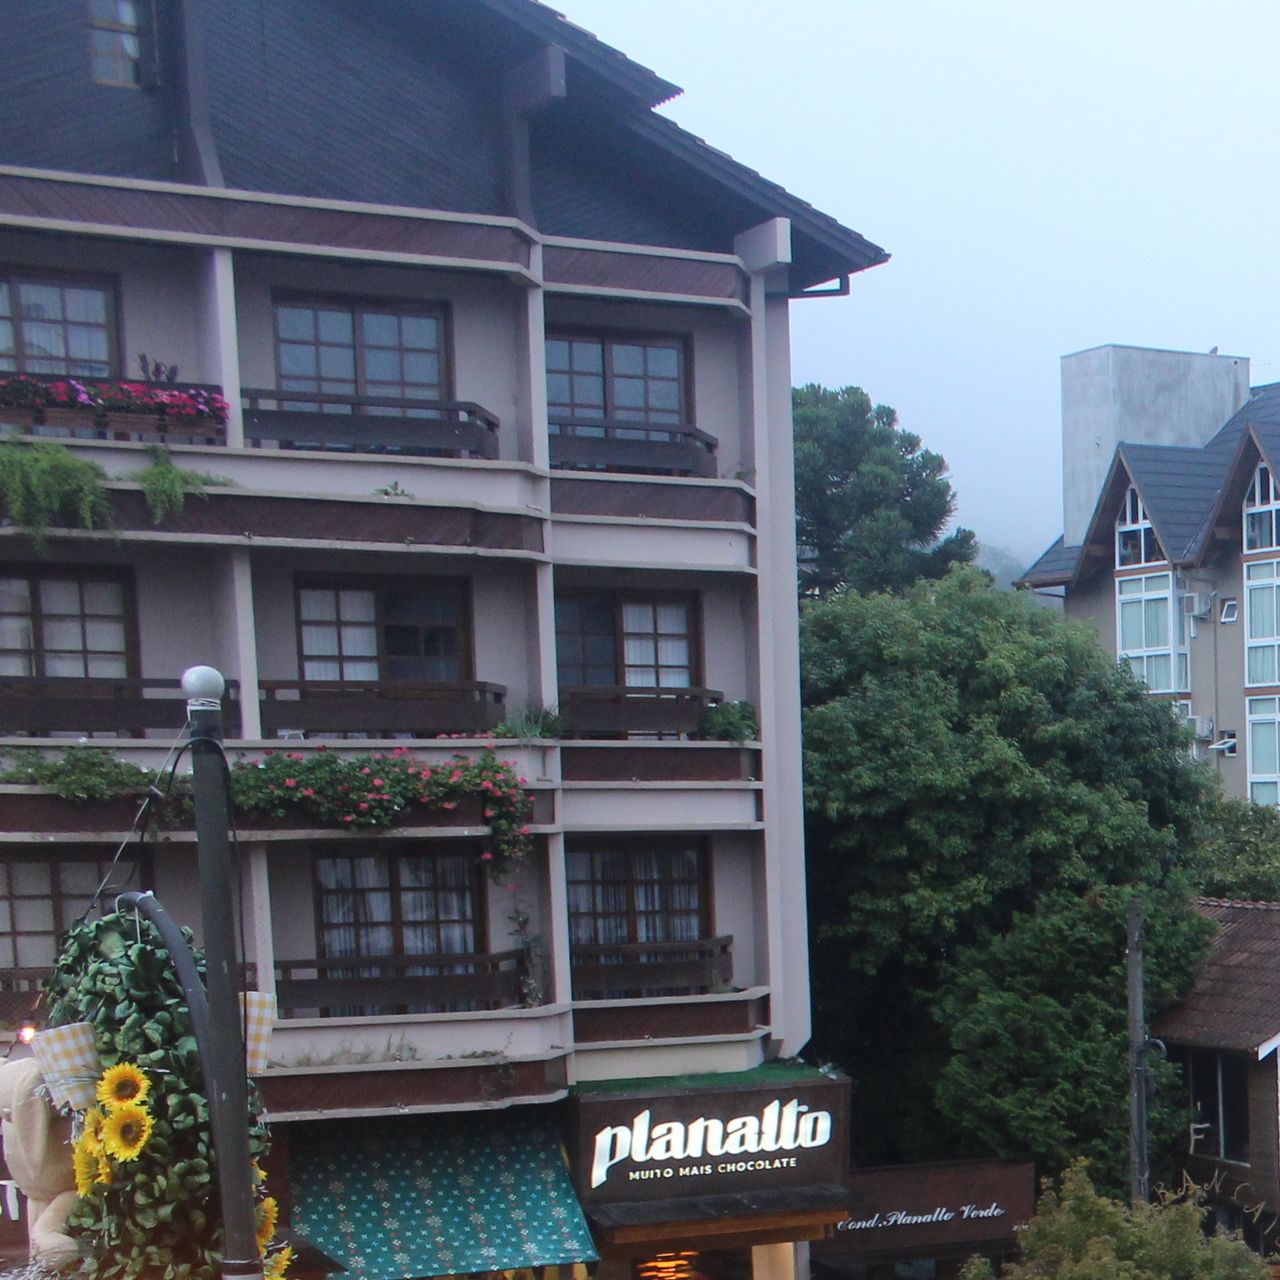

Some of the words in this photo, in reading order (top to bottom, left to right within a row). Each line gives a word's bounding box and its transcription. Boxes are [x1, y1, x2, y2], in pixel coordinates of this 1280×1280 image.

[591, 1098, 832, 1189] planalto
[628, 1169, 674, 1181] MUITO
[679, 1164, 713, 1178] MAIS
[717, 1157, 798, 1174] CHOCOLATE
[960, 1202, 1006, 1219] Verde
